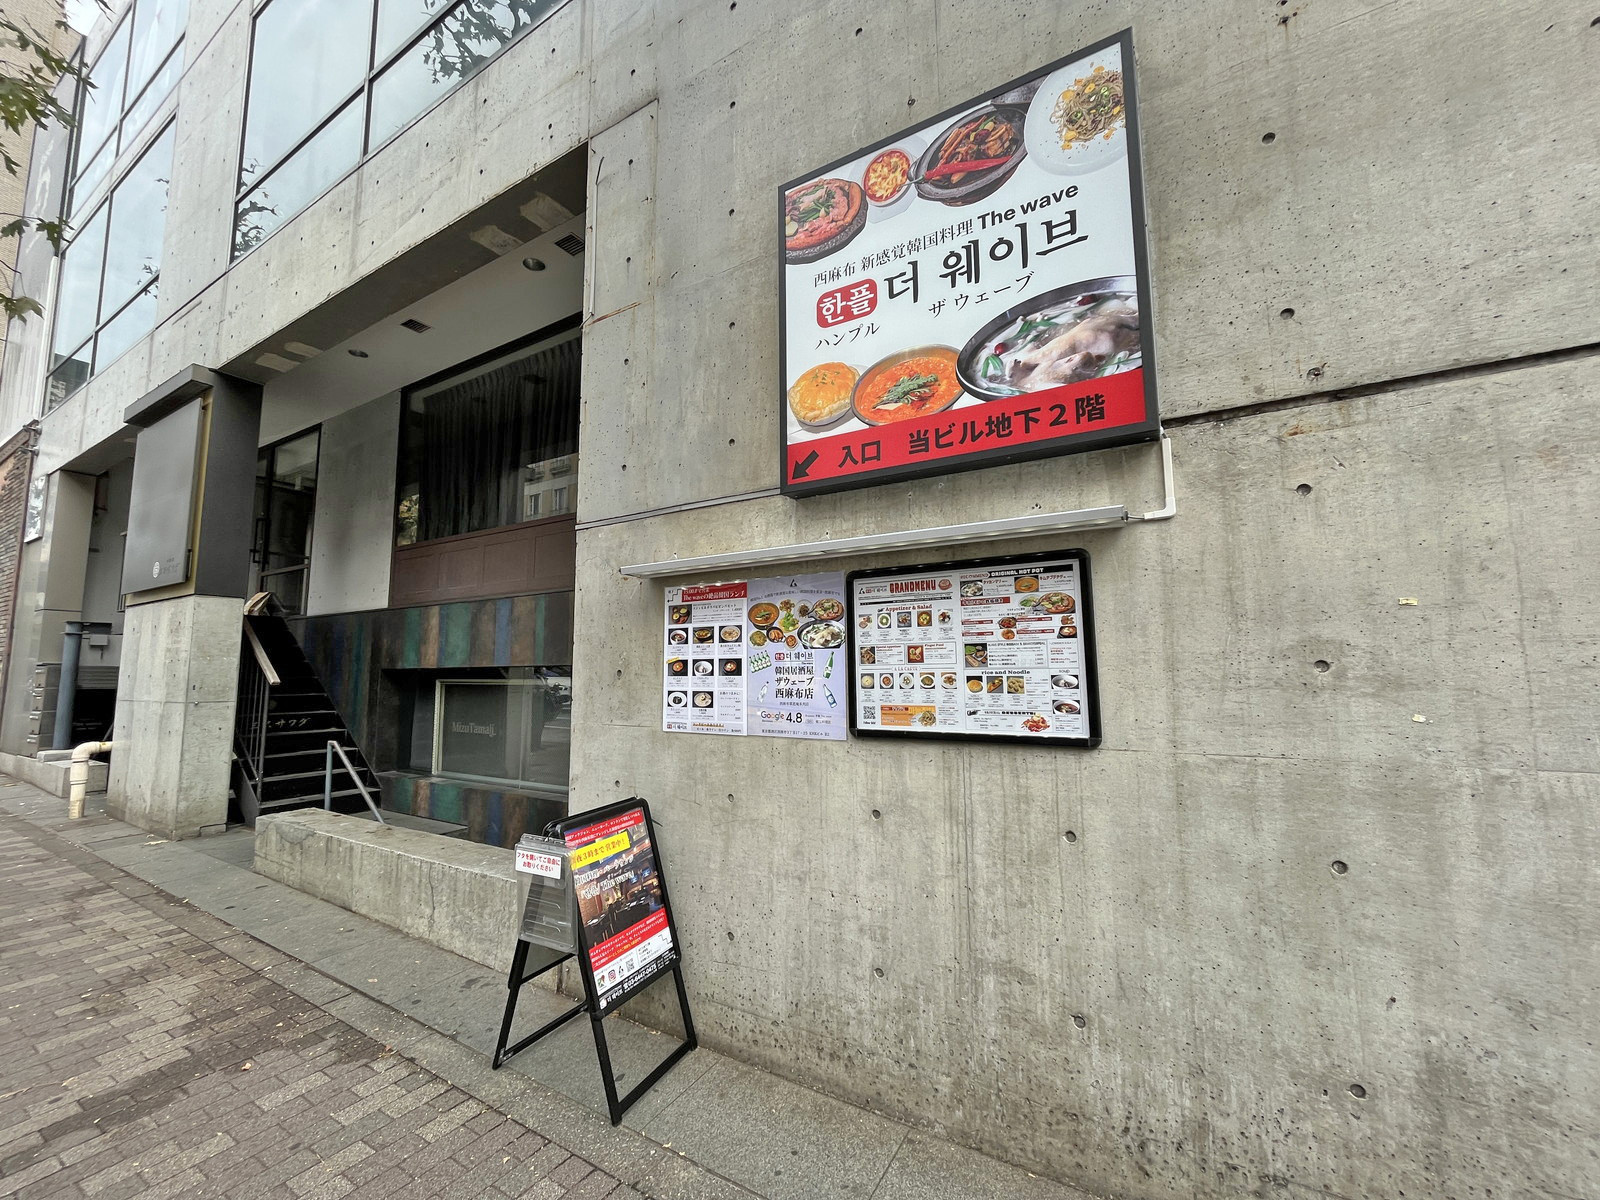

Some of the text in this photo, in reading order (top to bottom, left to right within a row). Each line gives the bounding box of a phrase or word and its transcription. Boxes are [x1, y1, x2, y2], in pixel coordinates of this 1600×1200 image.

[977, 184, 1079, 233] The wave
[813, 219, 974, 288] 西麻布 新感覚韓国料理
[884, 209, 1090, 304] 더 웨이브
[818, 283, 876, 321] 한플
[928, 271, 1035, 319] ザウェーブ
[815, 322, 881, 350] ハンプル
[838, 439, 882, 468] 入口
[775, 676, 815, 686] ザウェーブ
[775, 687, 814, 699] 西麻布店
[761, 711, 785, 721] Google
[786, 712, 803, 724] 4.8
[522, 861, 554, 872] お取りください
